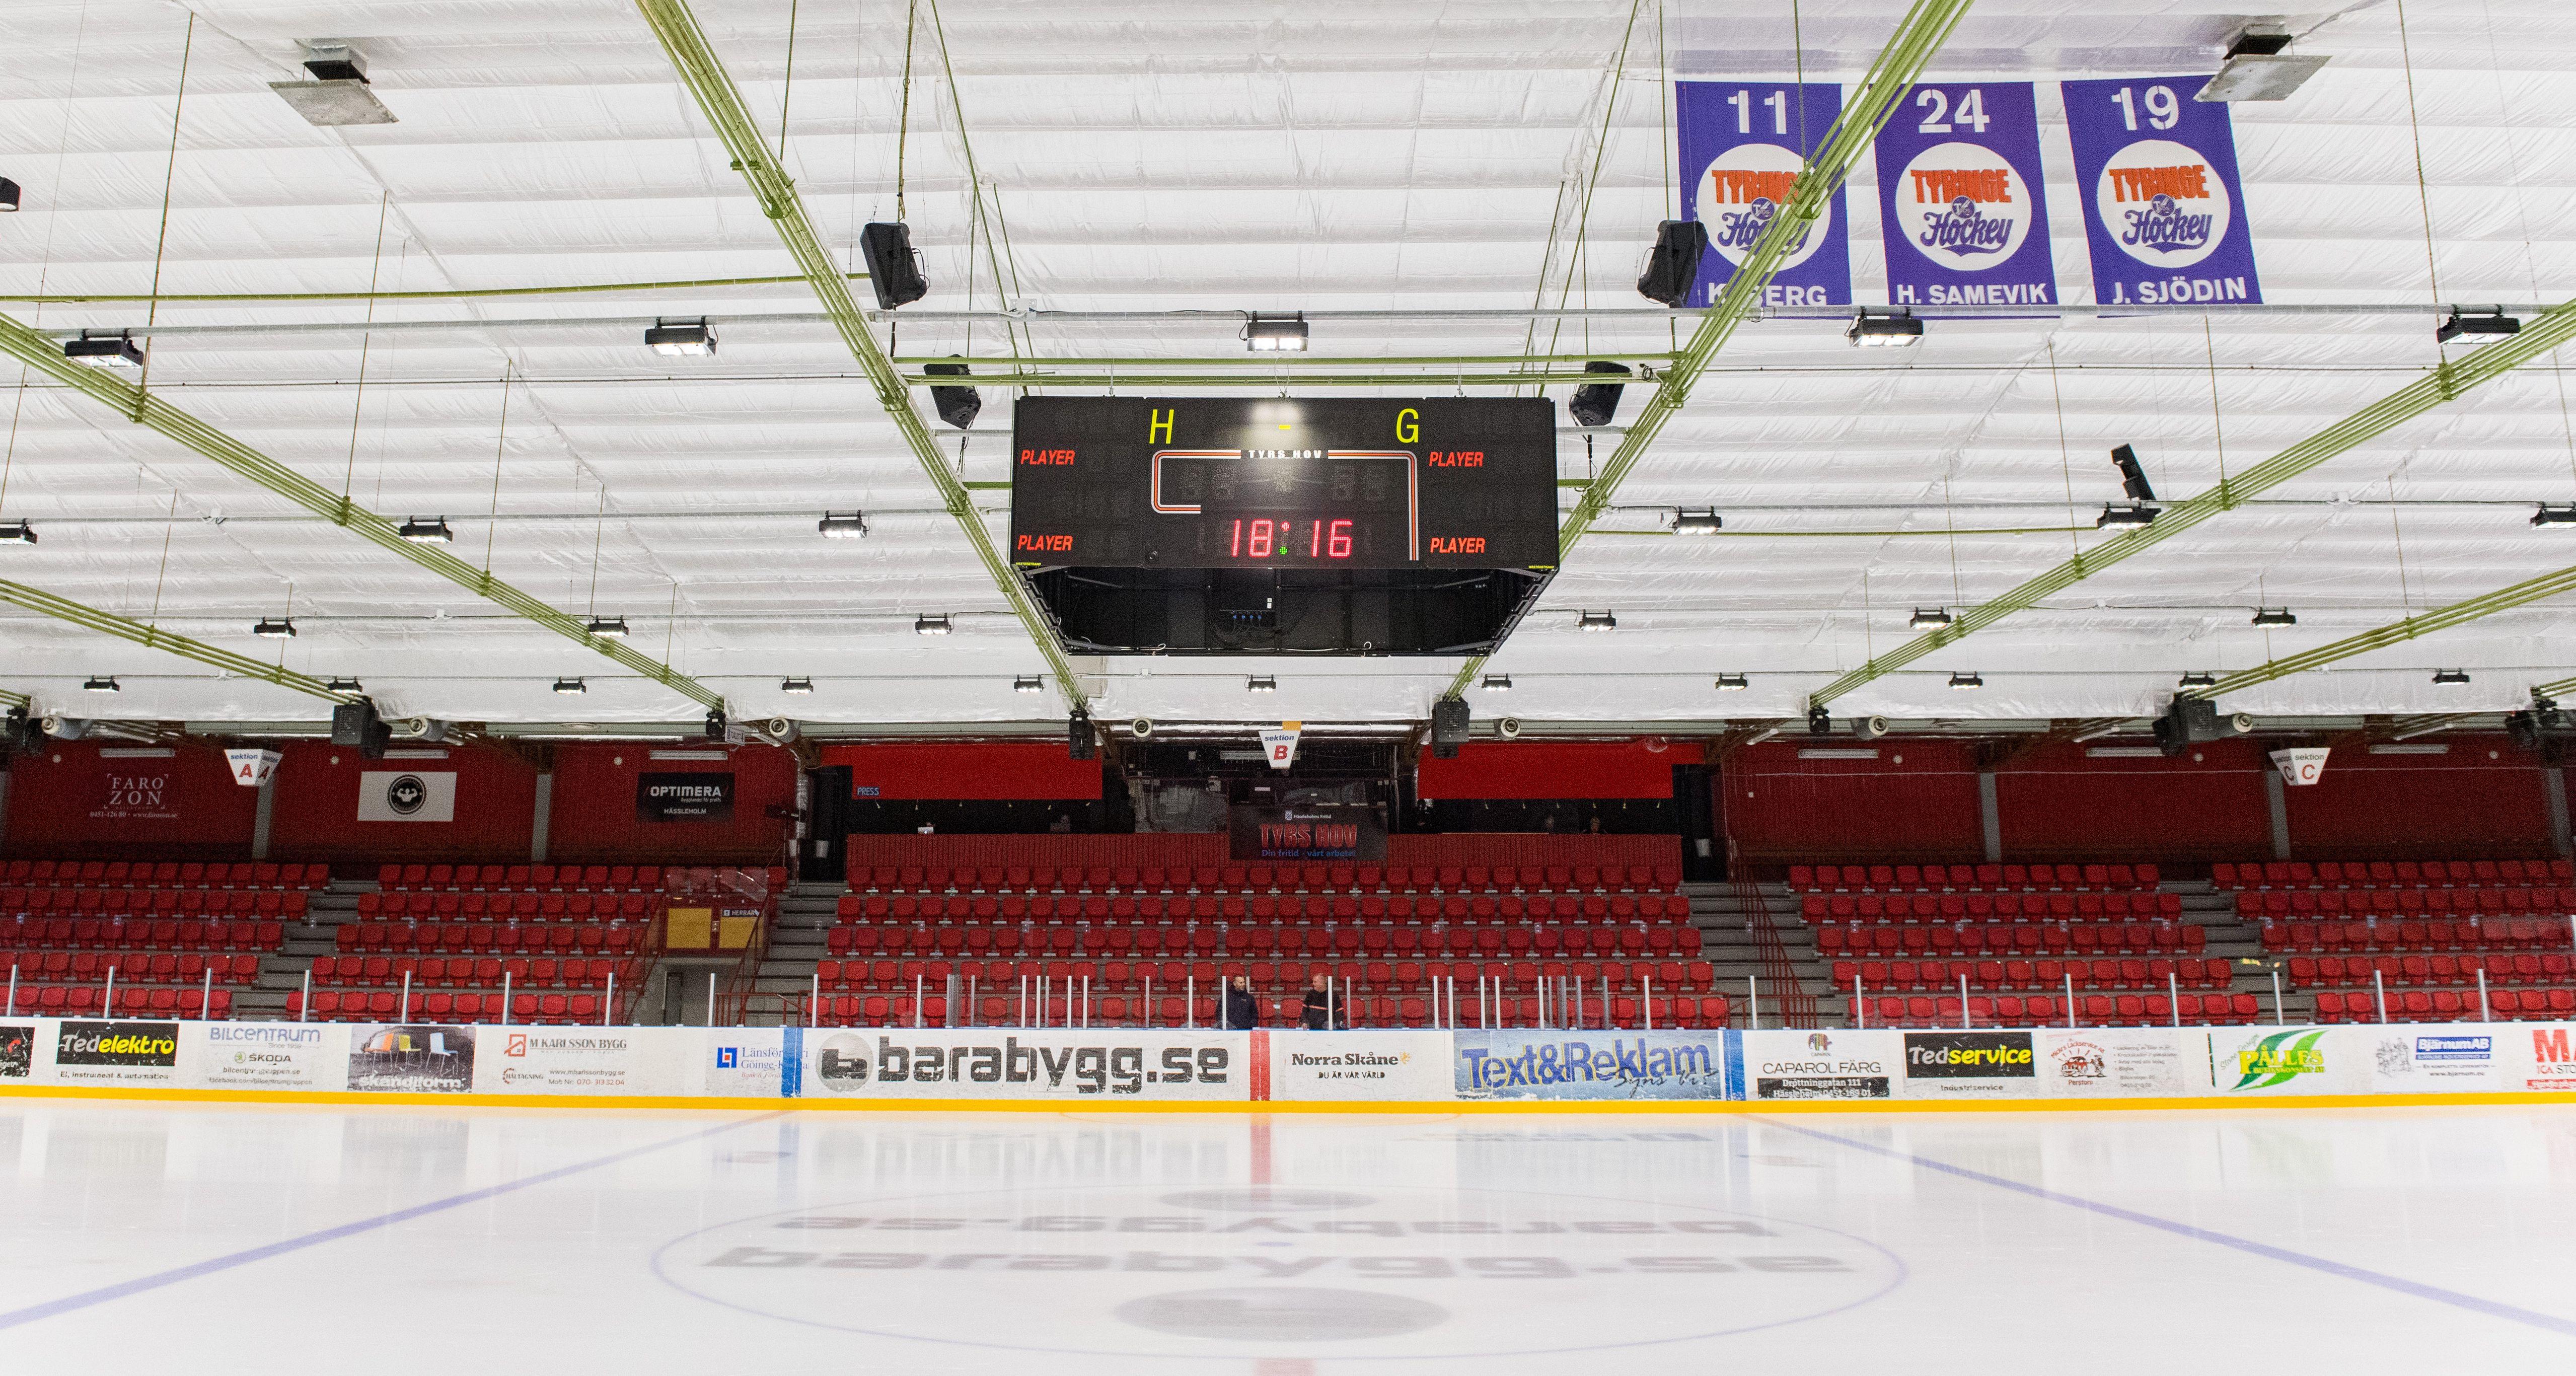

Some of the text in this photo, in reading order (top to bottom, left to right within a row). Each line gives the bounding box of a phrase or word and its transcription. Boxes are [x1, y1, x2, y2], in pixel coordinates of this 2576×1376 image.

[1728, 90, 1787, 134] 11
[1917, 89, 1990, 133] 24
[2111, 85, 2179, 131] 19
[1712, 170, 1799, 204] TYRING
[1910, 169, 2013, 203] TYRINGE
[2108, 165, 2210, 202] TYRINGE
[1920, 210, 2014, 254] Hockey
[2121, 206, 2213, 251] Hockey
[1896, 283, 2048, 304] H. SAMEVIK
[2112, 276, 2247, 304] J. SJÖDIN
[1149, 409, 1174, 444] H
[1395, 408, 1419, 443] G
[1020, 449, 1076, 465] PLAYER
[1248, 449, 1321, 459] TYRS HOV
[1429, 452, 1484, 467] PLAYER
[1017, 534, 1073, 551] PLAYER
[1231, 519, 1353, 558] 18:16
[1430, 537, 1486, 554] PLAYER
[1273, 745, 1288, 760] B
[239, 763, 253, 778] A
[2302, 764, 2315, 780] C
[112, 777, 164, 790] FARO
[649, 785, 722, 797] OPTIMERA
[857, 787, 879, 795] PRESS
[109, 790, 162, 805] ZON
[1259, 823, 1358, 848] TYRS HOV
[62, 1034, 175, 1055] Tedelektro
[529, 1038, 627, 1049] M KARLSSON BYGG
[2418, 1038, 2489, 1052] BjärnumAB
[2532, 1029, 2576, 1063] M
[248, 1052, 292, 1062] ŠKODA
[878, 1035, 1229, 1094] barabygg.se
[1291, 1051, 1399, 1066] Norra Skåne
[1460, 1038, 1712, 1091] Text&Reklam
[1908, 1044, 2032, 1065] Tedservice
[2238, 1045, 2324, 1074] PÅLLES
[1332, 1070, 1342, 1079] ÄR
[1362, 1070, 1385, 1079] VÄRLD
[1762, 1059, 1881, 1074] CAPAROL FÄRG
[703, 1247, 1857, 1279] barabygg.se
